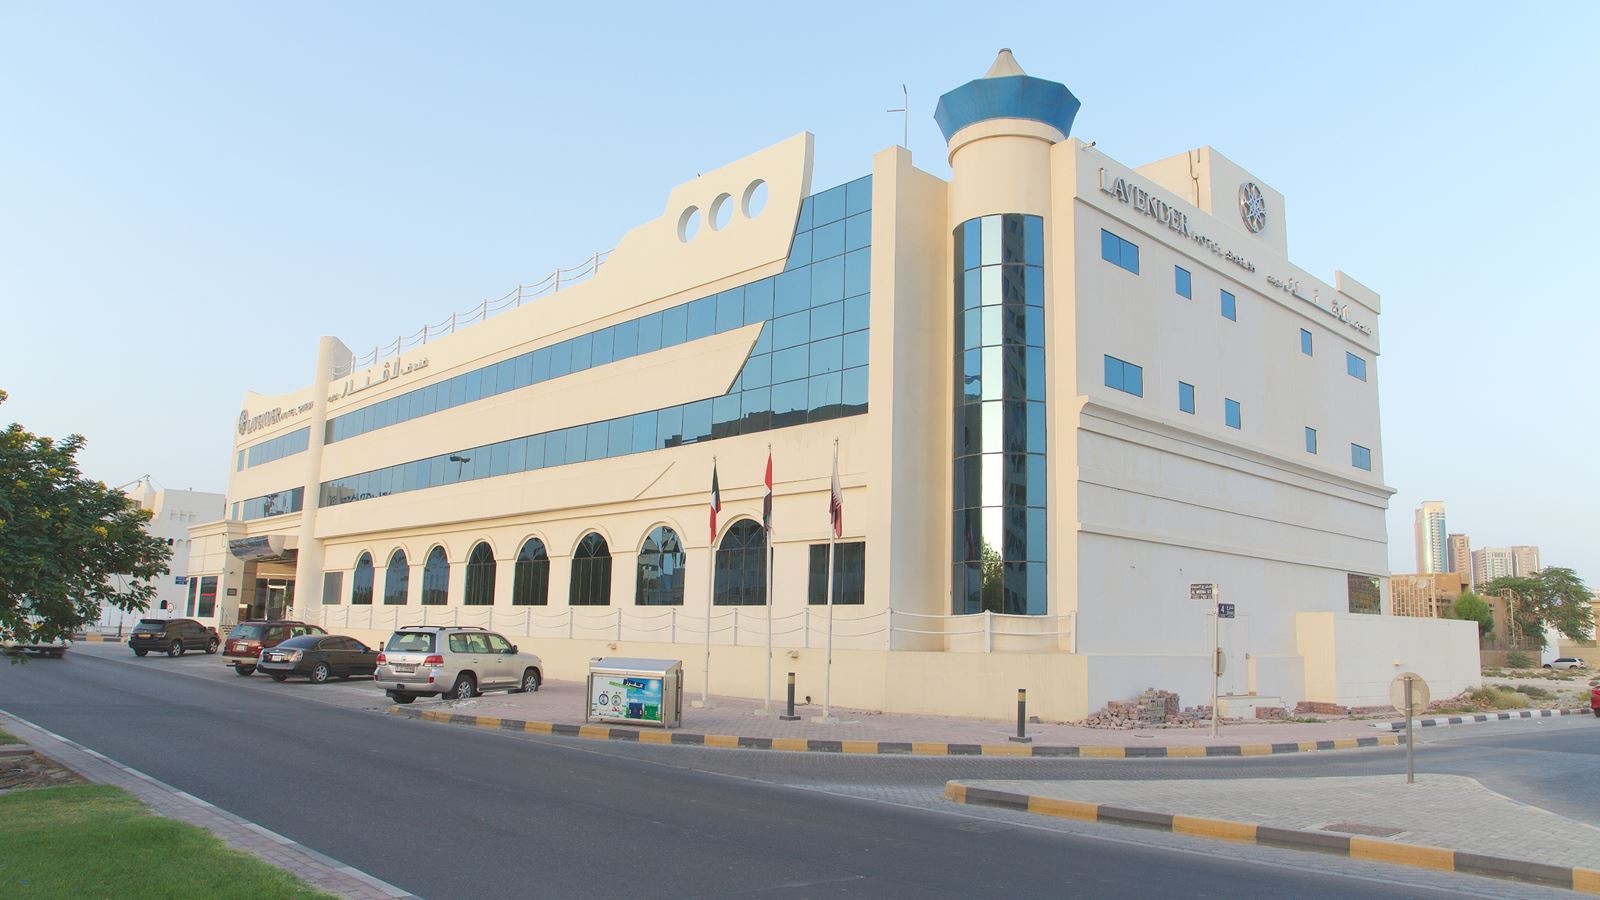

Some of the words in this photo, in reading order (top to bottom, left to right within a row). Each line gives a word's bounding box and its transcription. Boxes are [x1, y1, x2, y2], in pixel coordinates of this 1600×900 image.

[1099, 167, 1189, 238] LAVENDER
[1190, 231, 1224, 257] HOTEL
[247, 407, 282, 434] LAVENDER
